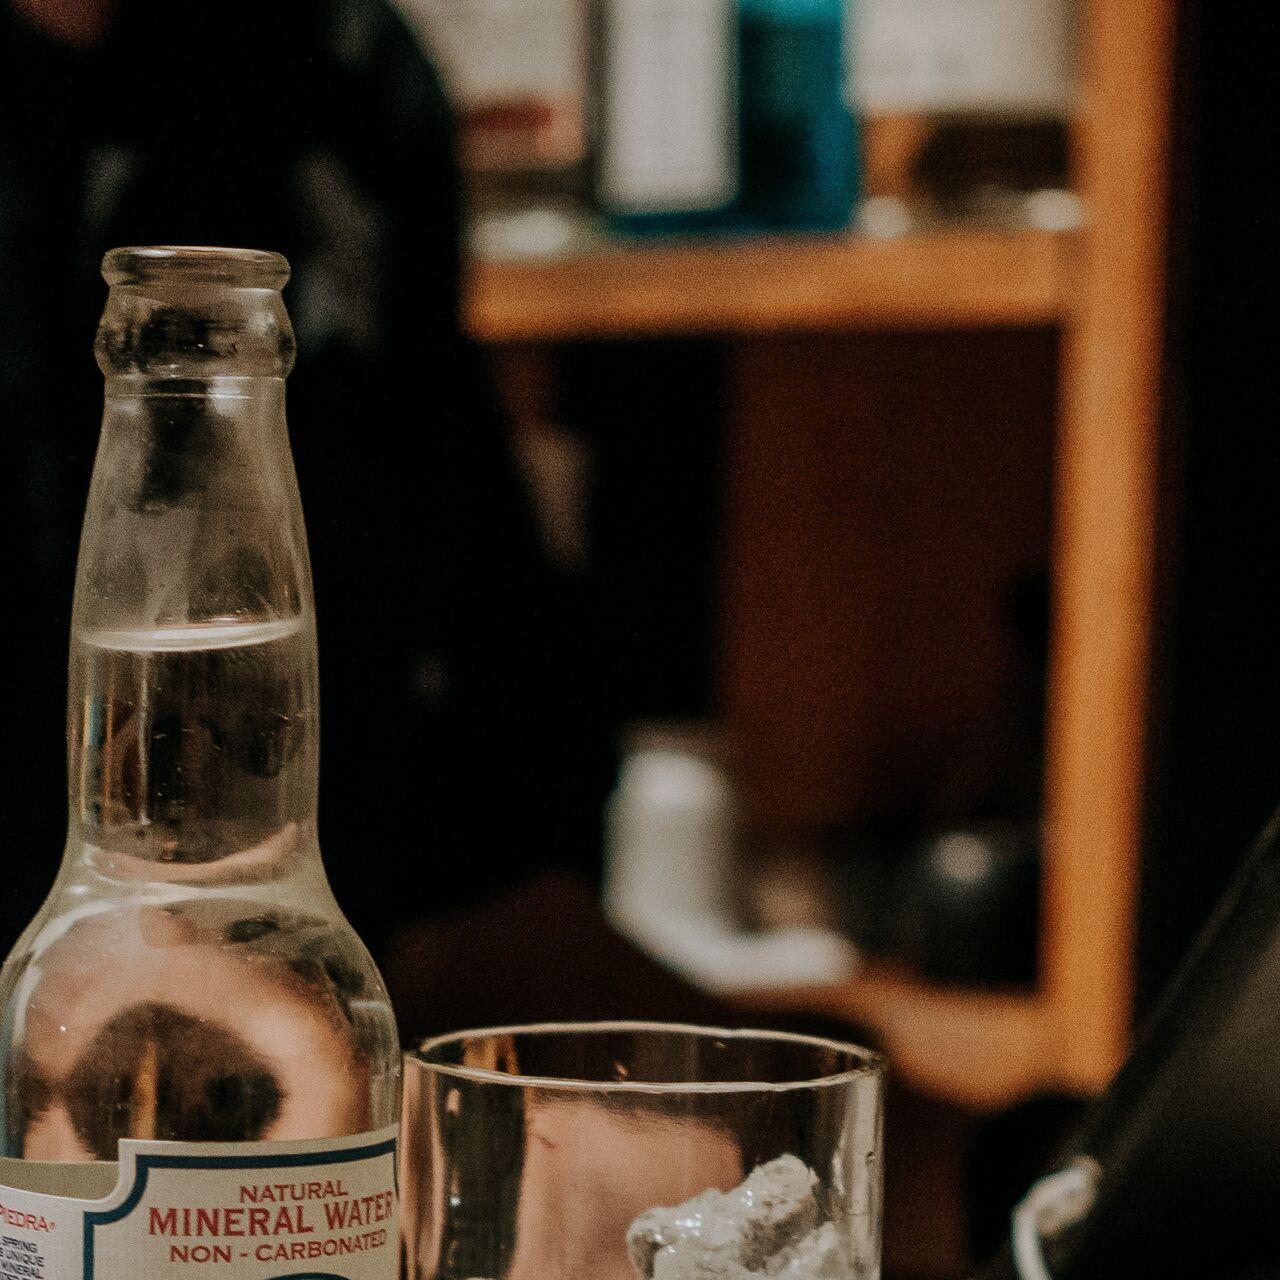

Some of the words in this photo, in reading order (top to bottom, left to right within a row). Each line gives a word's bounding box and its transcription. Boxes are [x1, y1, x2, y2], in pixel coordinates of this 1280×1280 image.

[239, 1180, 348, 1203] NATURAL
[148, 1206, 315, 1236] MINERAL
[324, 1190, 393, 1230] WATER
[170, 1245, 232, 1263] NON
[255, 1228, 388, 1262] CARBONATED
